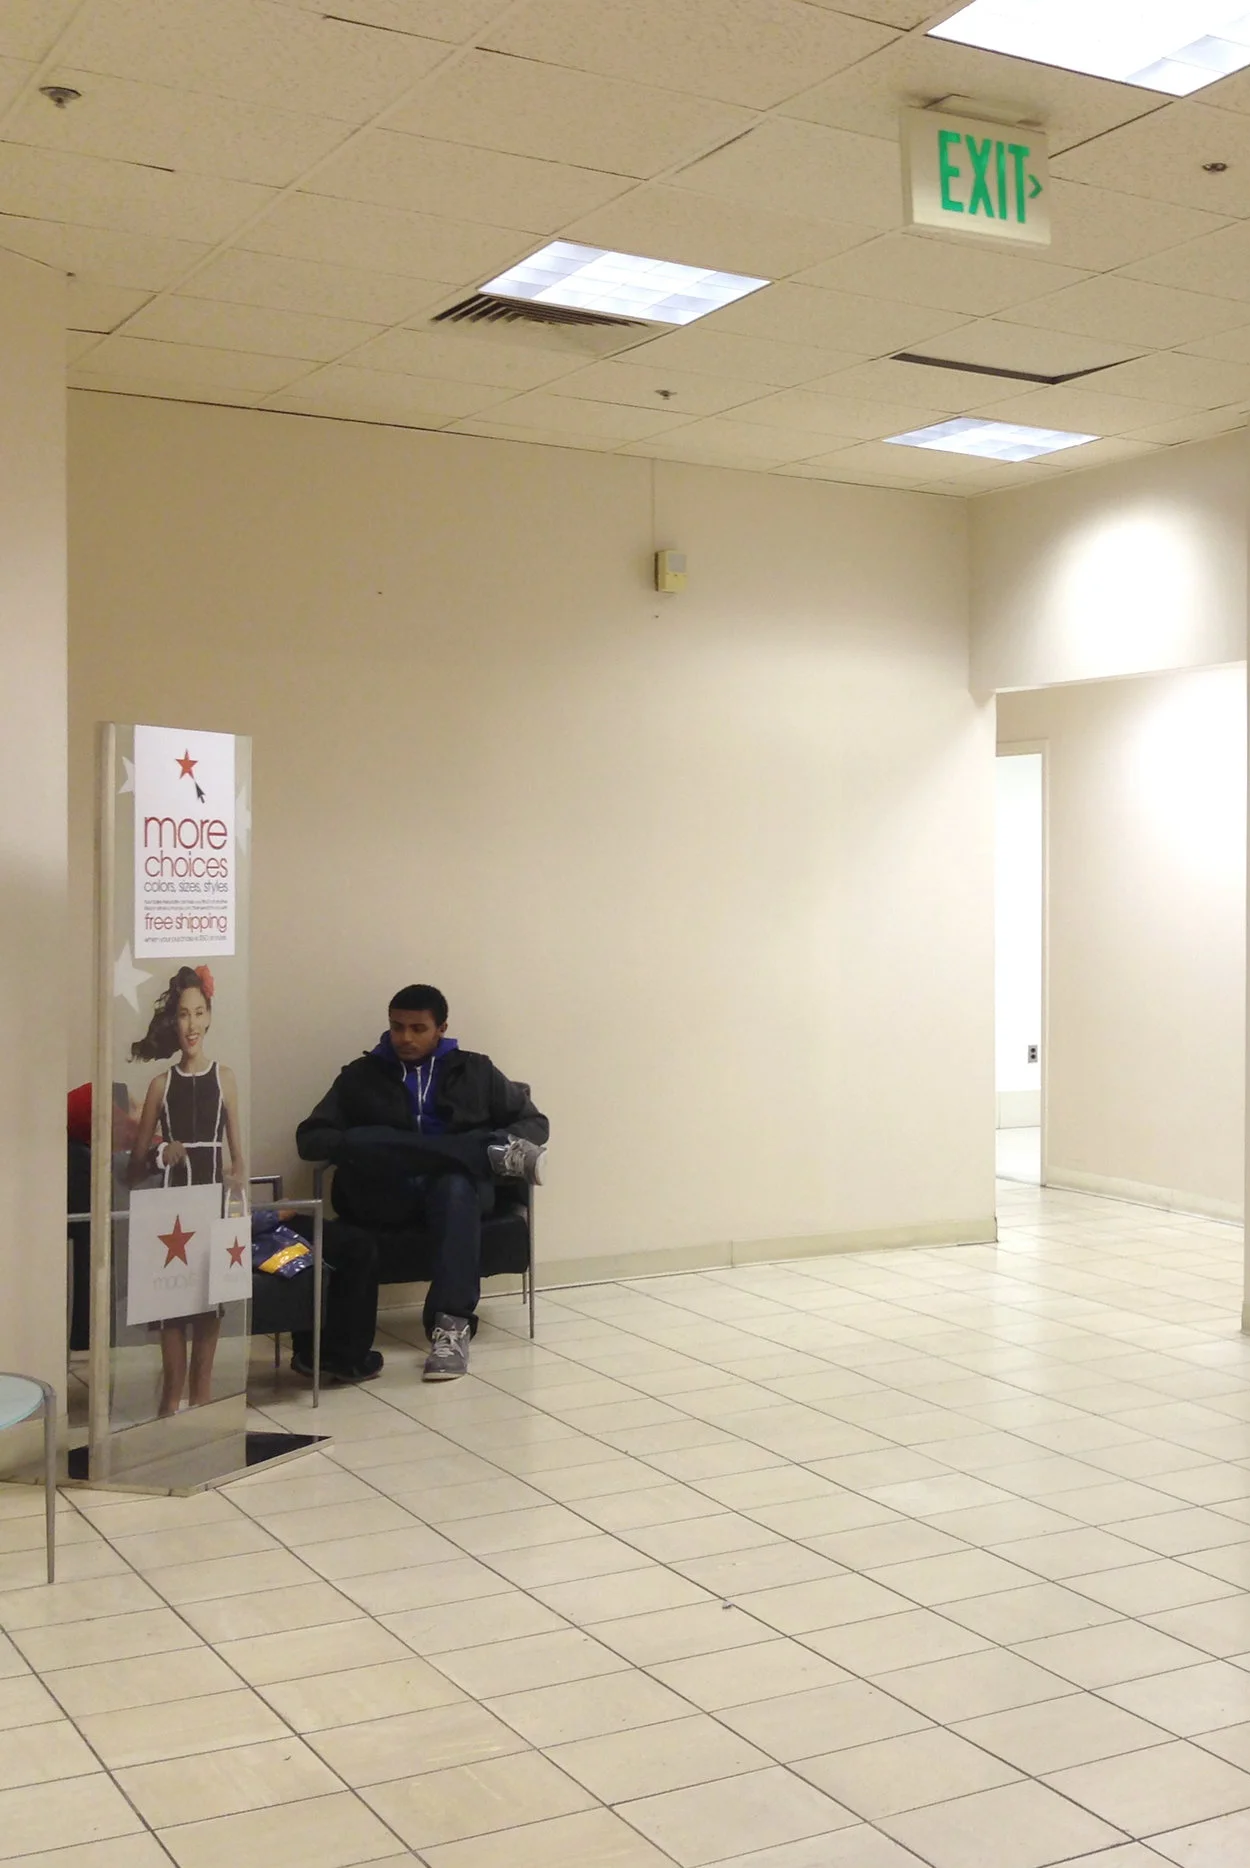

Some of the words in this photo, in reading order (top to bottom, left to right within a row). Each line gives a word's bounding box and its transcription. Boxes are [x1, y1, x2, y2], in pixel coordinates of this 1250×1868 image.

[938, 130, 1030, 224] EXIT
[144, 816, 228, 850] more
[144, 849, 229, 878] choices
[203, 880, 229, 895] styles
[144, 912, 174, 930] free
[175, 912, 228, 933] shipping
